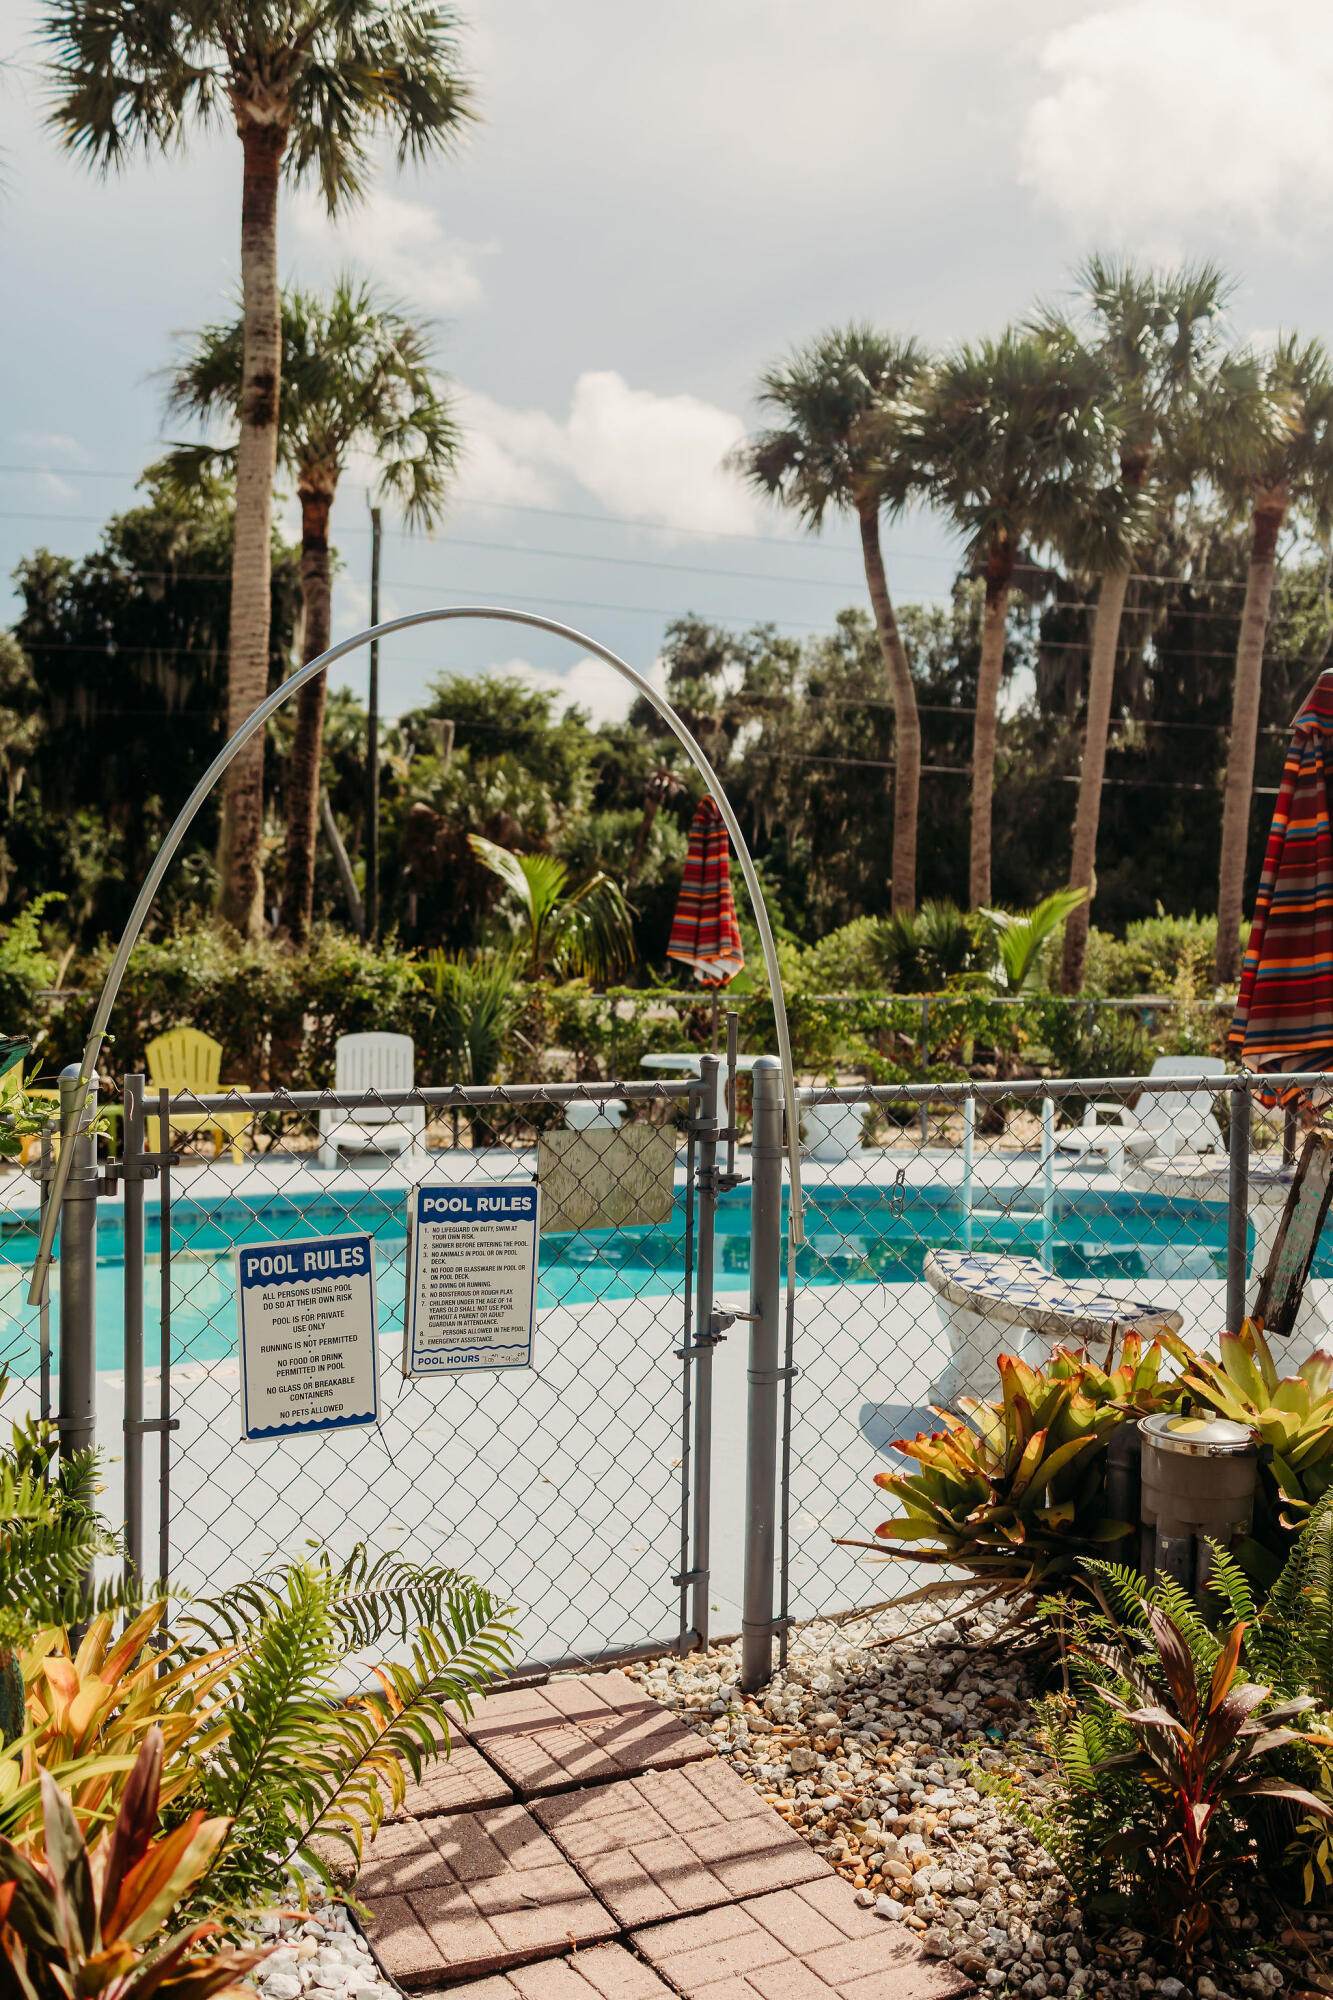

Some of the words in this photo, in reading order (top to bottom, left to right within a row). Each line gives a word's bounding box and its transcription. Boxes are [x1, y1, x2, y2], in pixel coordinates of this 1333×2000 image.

[423, 1198, 473, 1212] POOL
[477, 1197, 532, 1211] RULES
[247, 1254, 299, 1278] POOL
[303, 1247, 365, 1271] RULES
[277, 1289, 310, 1299] PERSONS
[311, 1286, 333, 1295] USING
[334, 1284, 352, 1292] POOL
[275, 1301, 285, 1309] SO
[286, 1300, 295, 1308] AT
[296, 1297, 317, 1306] THEIR
[318, 1296, 335, 1304] OWN
[336, 1293, 353, 1302] RISK
[272, 1317, 291, 1325] POOL
[301, 1314, 315, 1322] FOR
[316, 1310, 345, 1320] PRIVATE
[292, 1325, 307, 1333] USE
[308, 1322, 326, 1331] ONLY
[260, 1343, 293, 1353] RUNNING
[319, 1335, 358, 1346] PERMITTED
[289, 1357, 308, 1366] FOOD
[309, 1355, 320, 1363] OR
[321, 1353, 343, 1361] DRINK
[418, 1357, 444, 1365] POOL
[446, 1355, 479, 1364] HOURS
[276, 1366, 316, 1377] PERMITTED
[327, 1362, 345, 1371] POOL
[267, 1387, 277, 1395] NO
[278, 1383, 301, 1393] GLASS
[314, 1377, 356, 1389] BREAKABLE
[290, 1389, 334, 1401] CONTAINERS
[292, 1408, 310, 1417] PETS
[310, 1403, 344, 1414] ALLOWED
